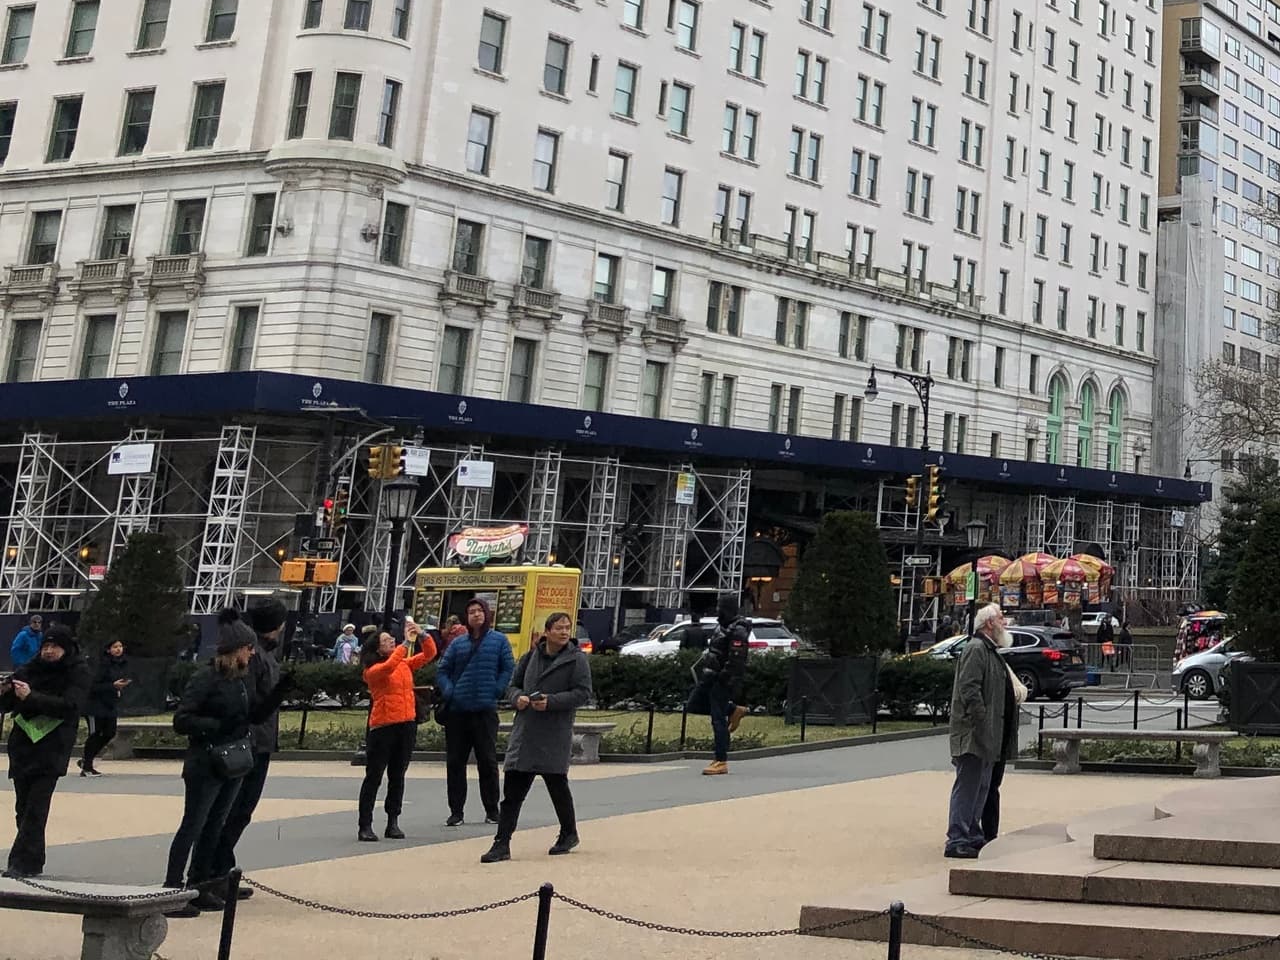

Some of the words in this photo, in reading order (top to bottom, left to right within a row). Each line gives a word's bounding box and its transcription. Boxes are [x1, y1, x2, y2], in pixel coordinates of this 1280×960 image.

[421, 575, 434, 584] THIS
[435, 575, 442, 584] IS
[444, 575, 456, 584] THE
[457, 575, 487, 584] ORIGINAL
[489, 575, 509, 584] SINCE
[537, 587, 550, 596] HOT
[550, 588, 567, 597] DOGS
